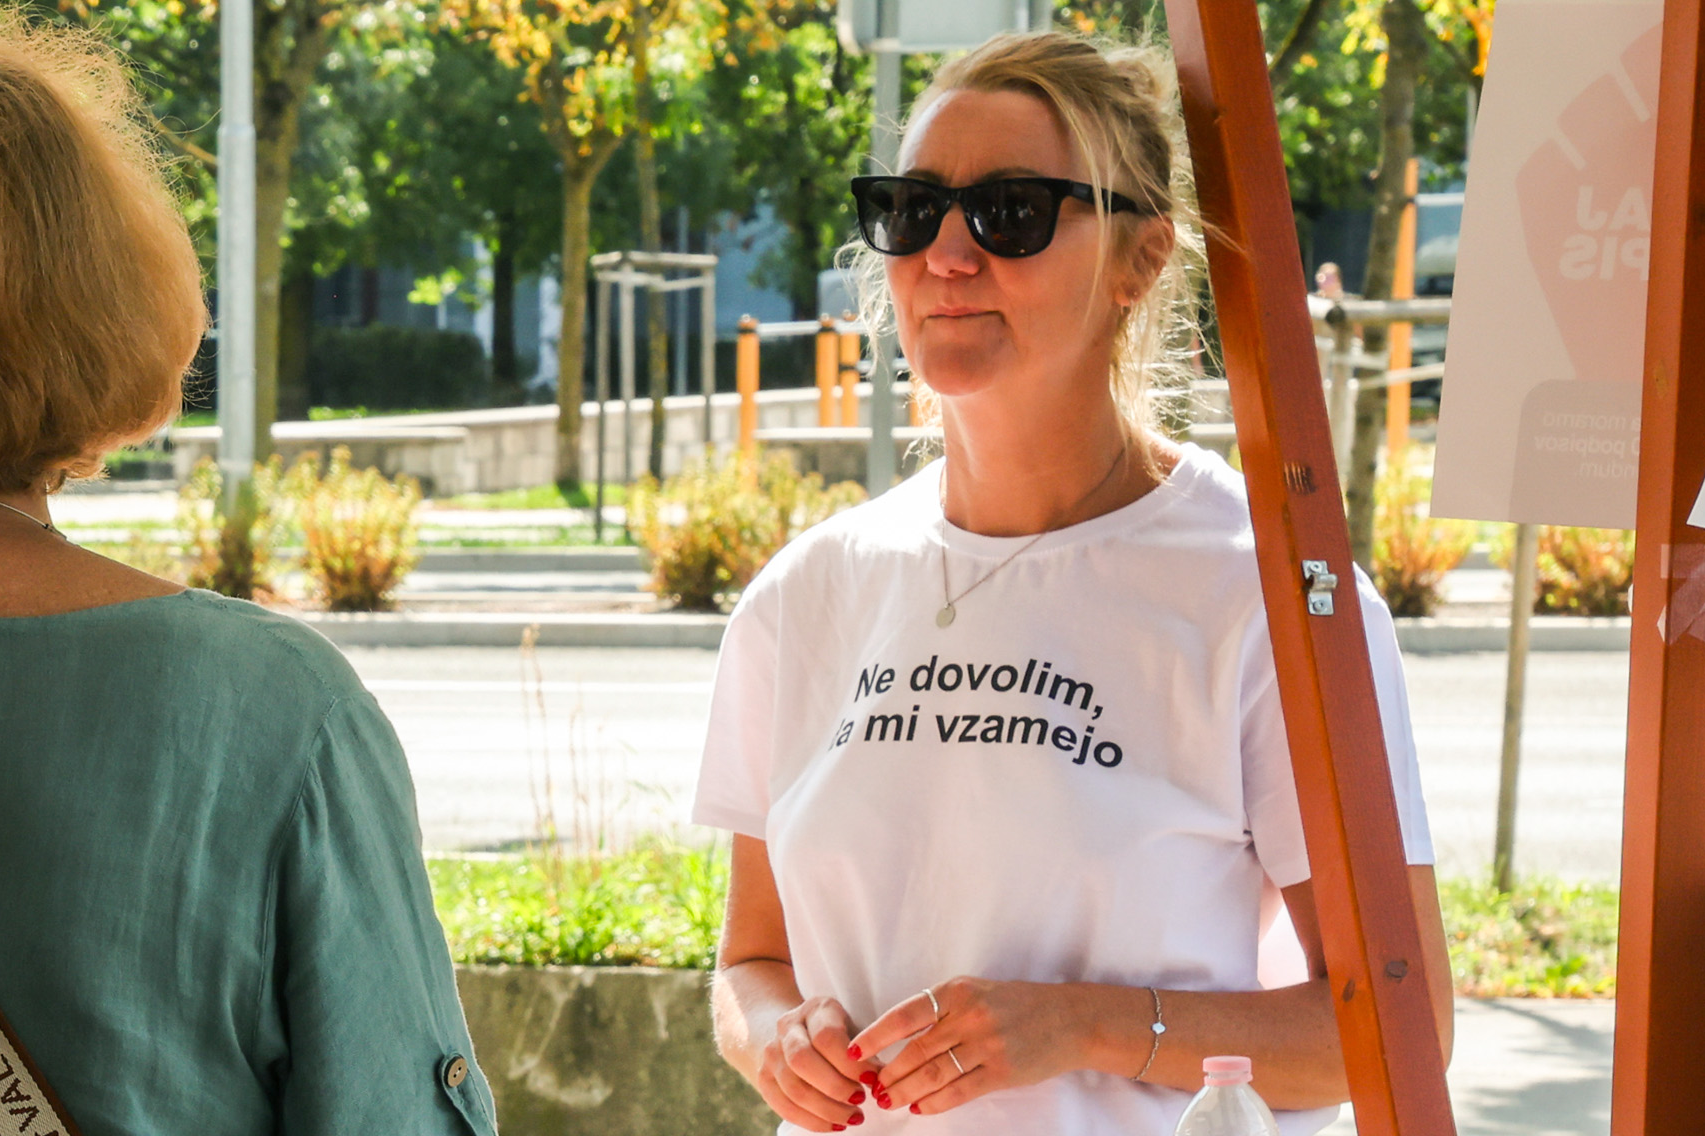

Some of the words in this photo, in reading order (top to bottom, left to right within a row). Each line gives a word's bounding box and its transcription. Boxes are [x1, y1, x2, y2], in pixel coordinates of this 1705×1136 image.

[854, 663, 895, 703] Ne
[910, 655, 1104, 720] dovolim,
[864, 705, 920, 742] mi
[935, 714, 1123, 768] vzamejo
